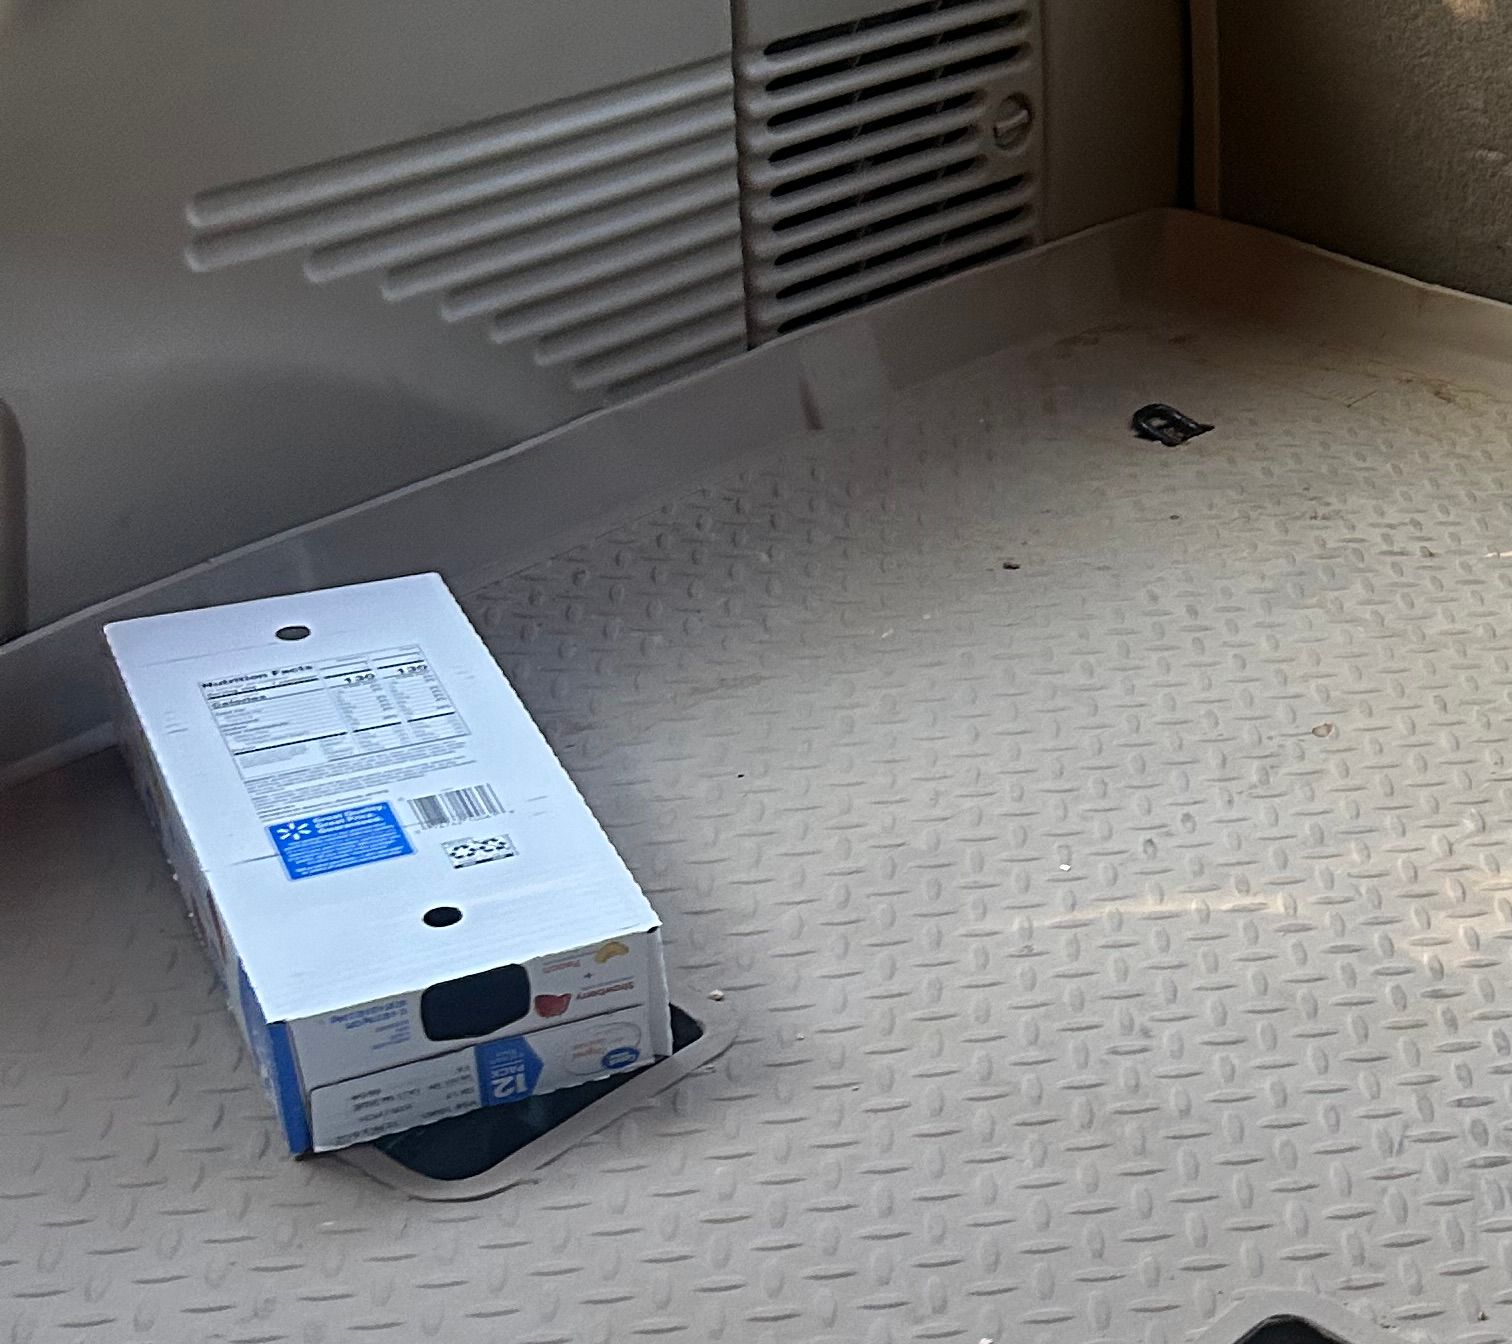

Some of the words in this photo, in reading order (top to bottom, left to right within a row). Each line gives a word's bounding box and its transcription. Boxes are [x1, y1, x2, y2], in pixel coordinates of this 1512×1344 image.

[202, 672, 268, 688] Nutrition
[271, 665, 313, 677] Facts
[345, 673, 376, 685] 130
[491, 1063, 525, 1080] PACK
[493, 1073, 529, 1099] 12
